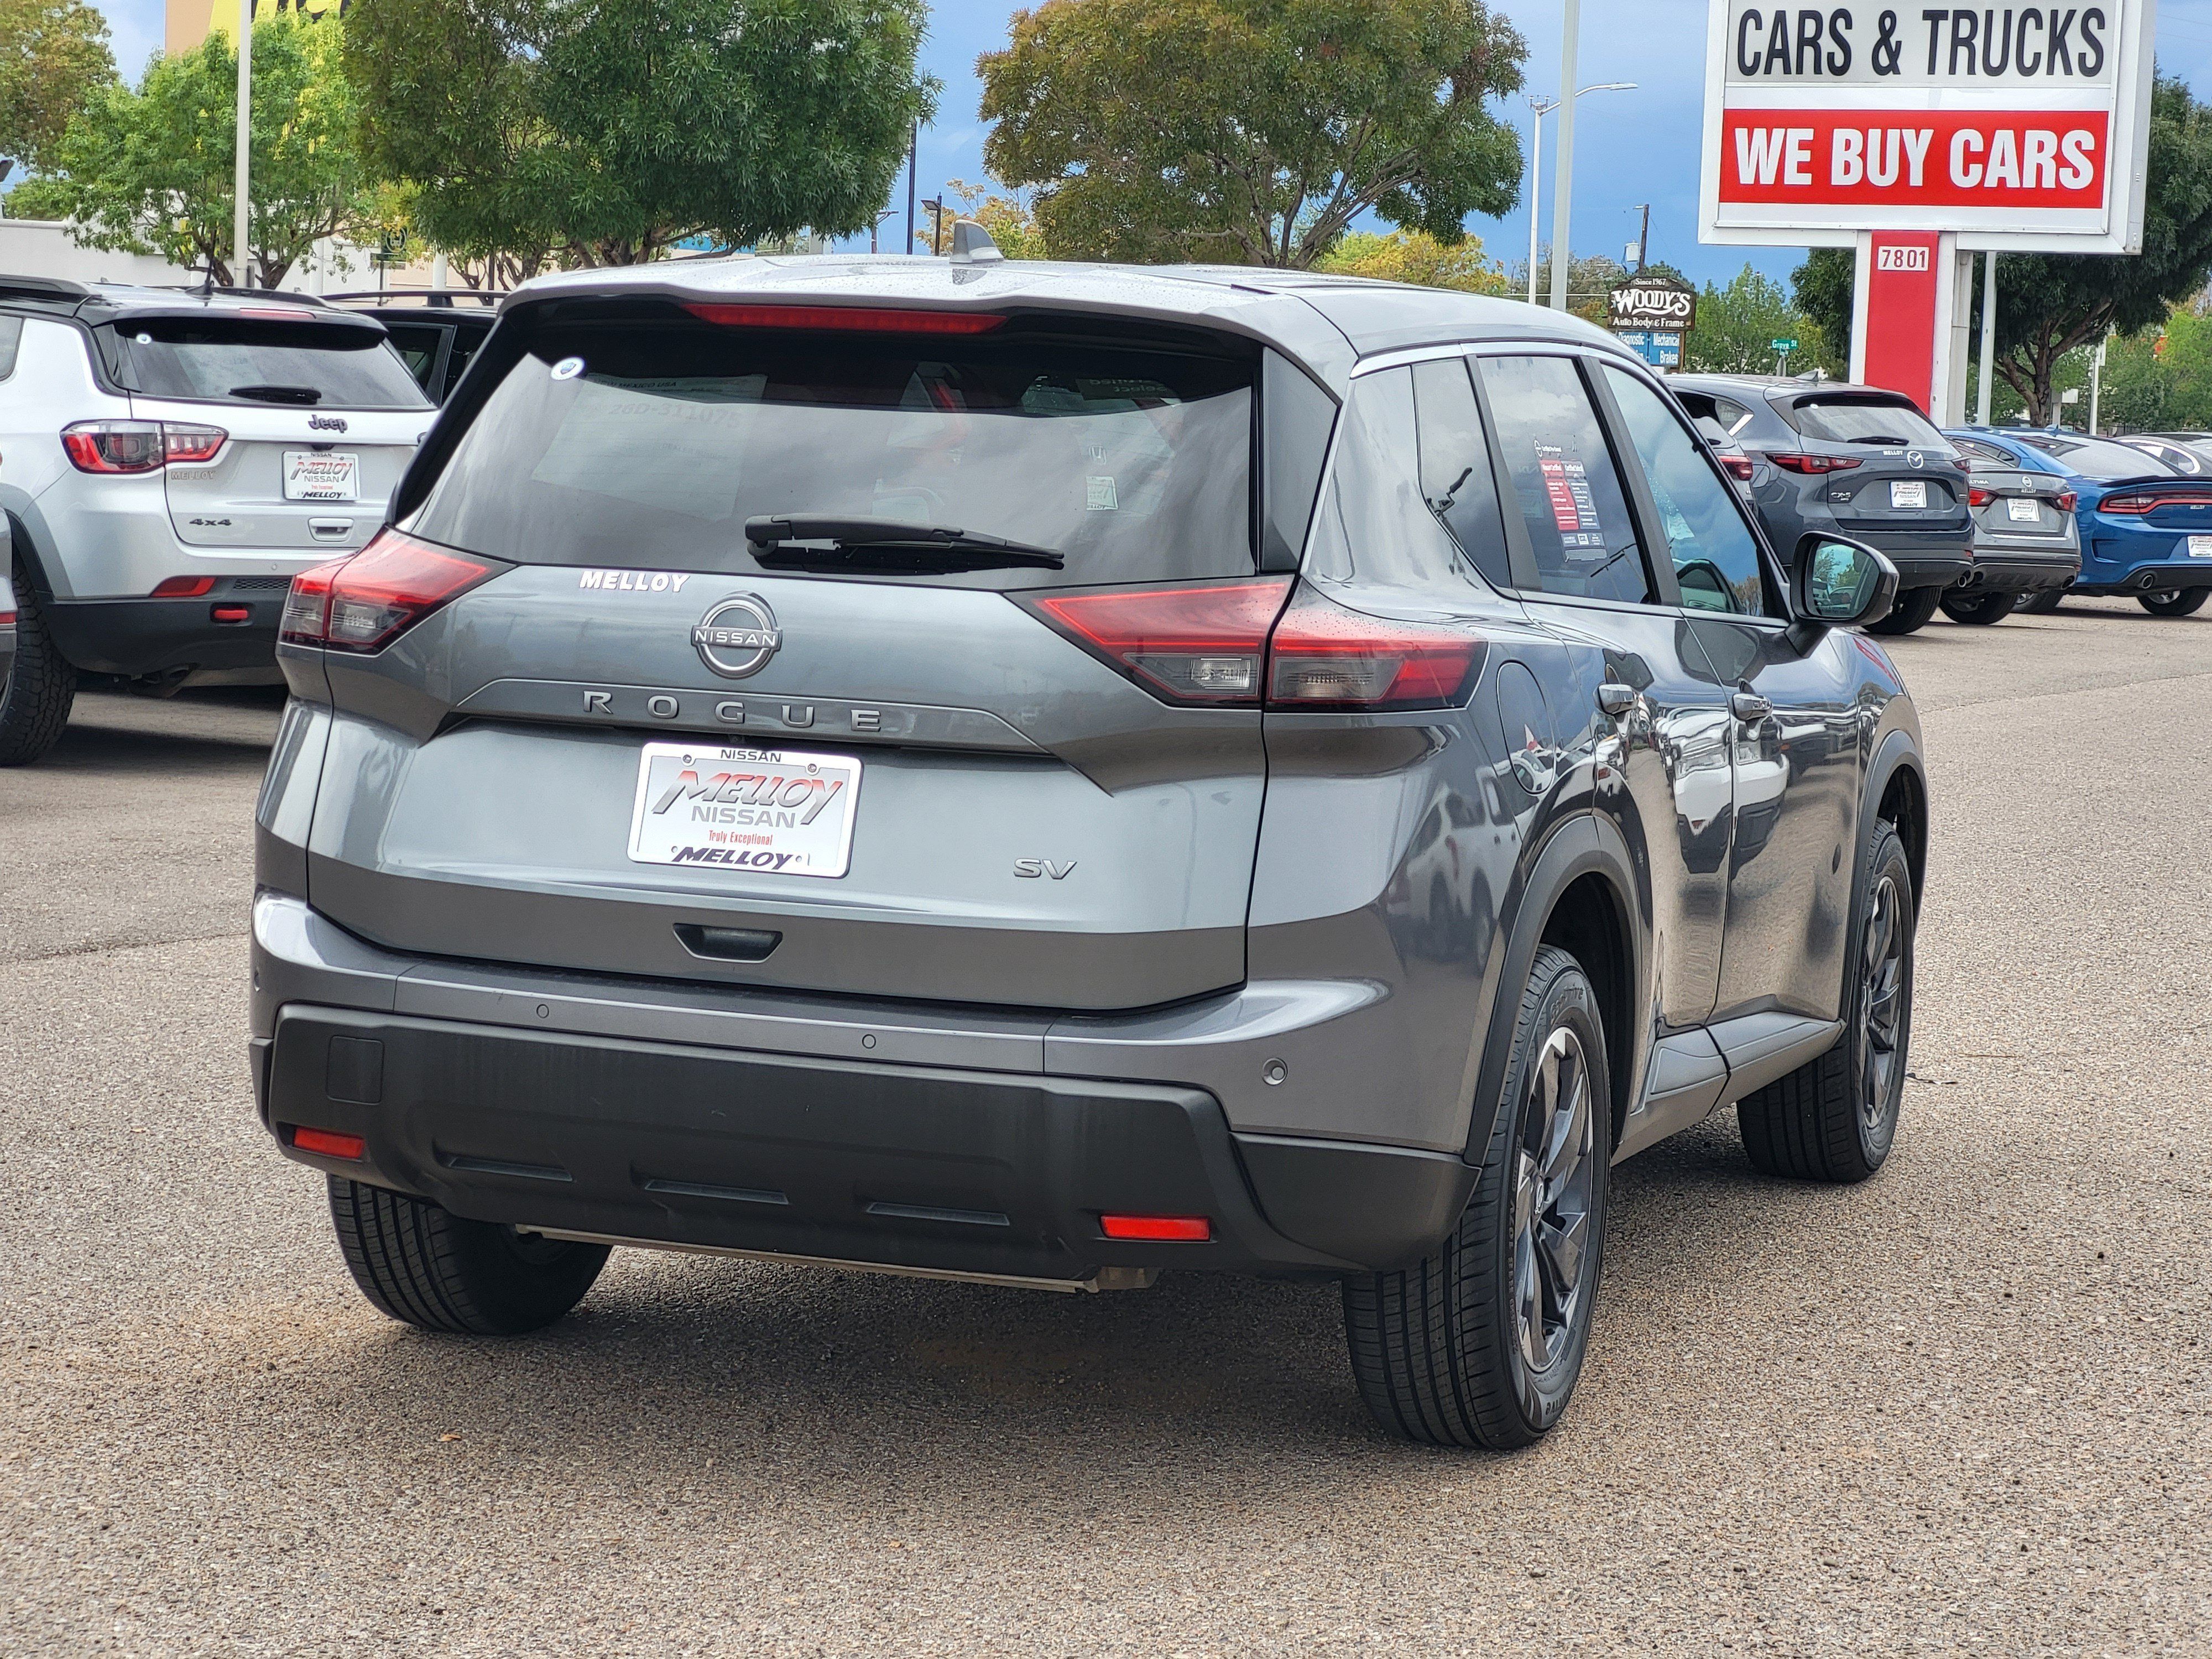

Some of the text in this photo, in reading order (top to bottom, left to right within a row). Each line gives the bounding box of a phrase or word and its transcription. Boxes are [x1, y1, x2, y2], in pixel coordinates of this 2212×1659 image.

[1738, 8, 2105, 77] CARS & TRUCKS
[1735, 128, 2095, 190] WE BUY CARS
[1882, 249, 1926, 268] 7801
[1611, 289, 1691, 316] WOODY'S
[1613, 317, 1631, 326] Auto
[1632, 317, 1653, 328] Body
[1661, 318, 1684, 327] Frame
[1660, 350, 1678, 364] Brakes
[307, 414, 348, 434] Jeep
[171, 470, 216, 480] MELLOY
[290, 461, 353, 481] MELLOY
[579, 570, 691, 593] MELLOY
[695, 629, 776, 646] NISSAN
[582, 691, 882, 732] ROGUE
[721, 749, 782, 763] NISSAN
[651, 770, 844, 825] MELLOY
[691, 805, 796, 829] NISSAN
[708, 830, 773, 846] Truly Exceptional
[671, 846, 794, 870] MELLOY
[1013, 858, 1078, 880] SV
